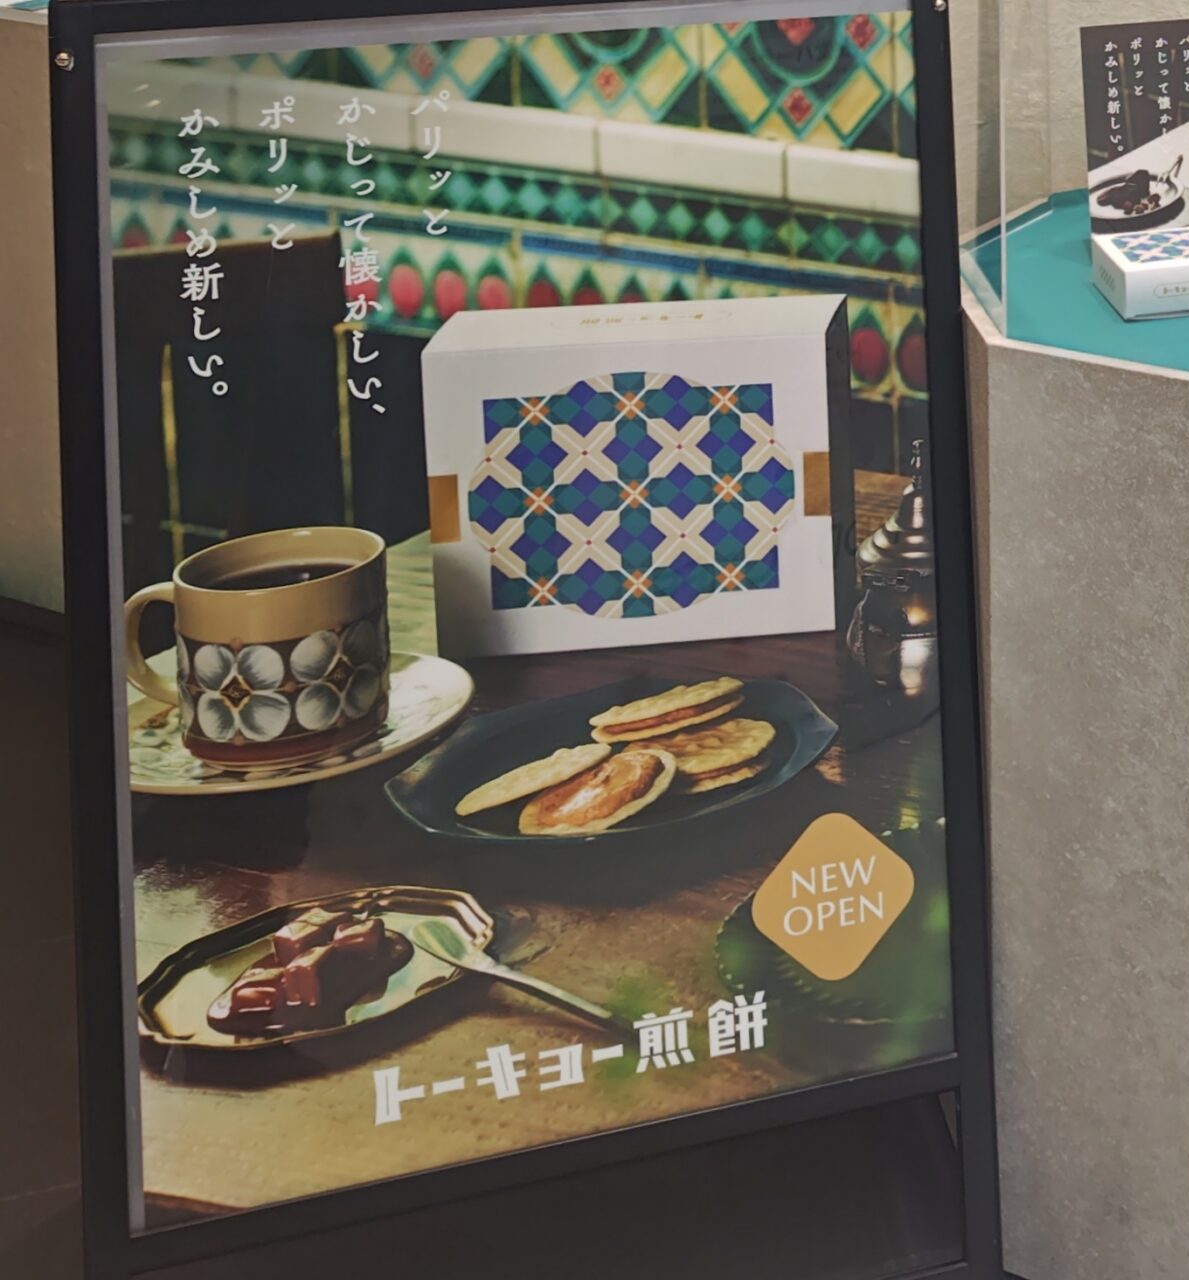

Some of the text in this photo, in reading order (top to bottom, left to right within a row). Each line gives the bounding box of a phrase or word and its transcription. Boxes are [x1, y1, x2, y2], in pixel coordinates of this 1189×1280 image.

[1104, 41, 1124, 152] かみしめ新しい。
[1130, 37, 1144, 96] ポリッと
[259, 96, 298, 250] ポリッと
[411, 90, 451, 235] パリッと
[178, 108, 228, 396] かみしめ新しい。
[337, 97, 386, 414] かじって懐かしい、
[783, 891, 884, 937] OPEN
[790, 856, 877, 899] NEW
[374, 991, 767, 1125] トーキョー煎餅
